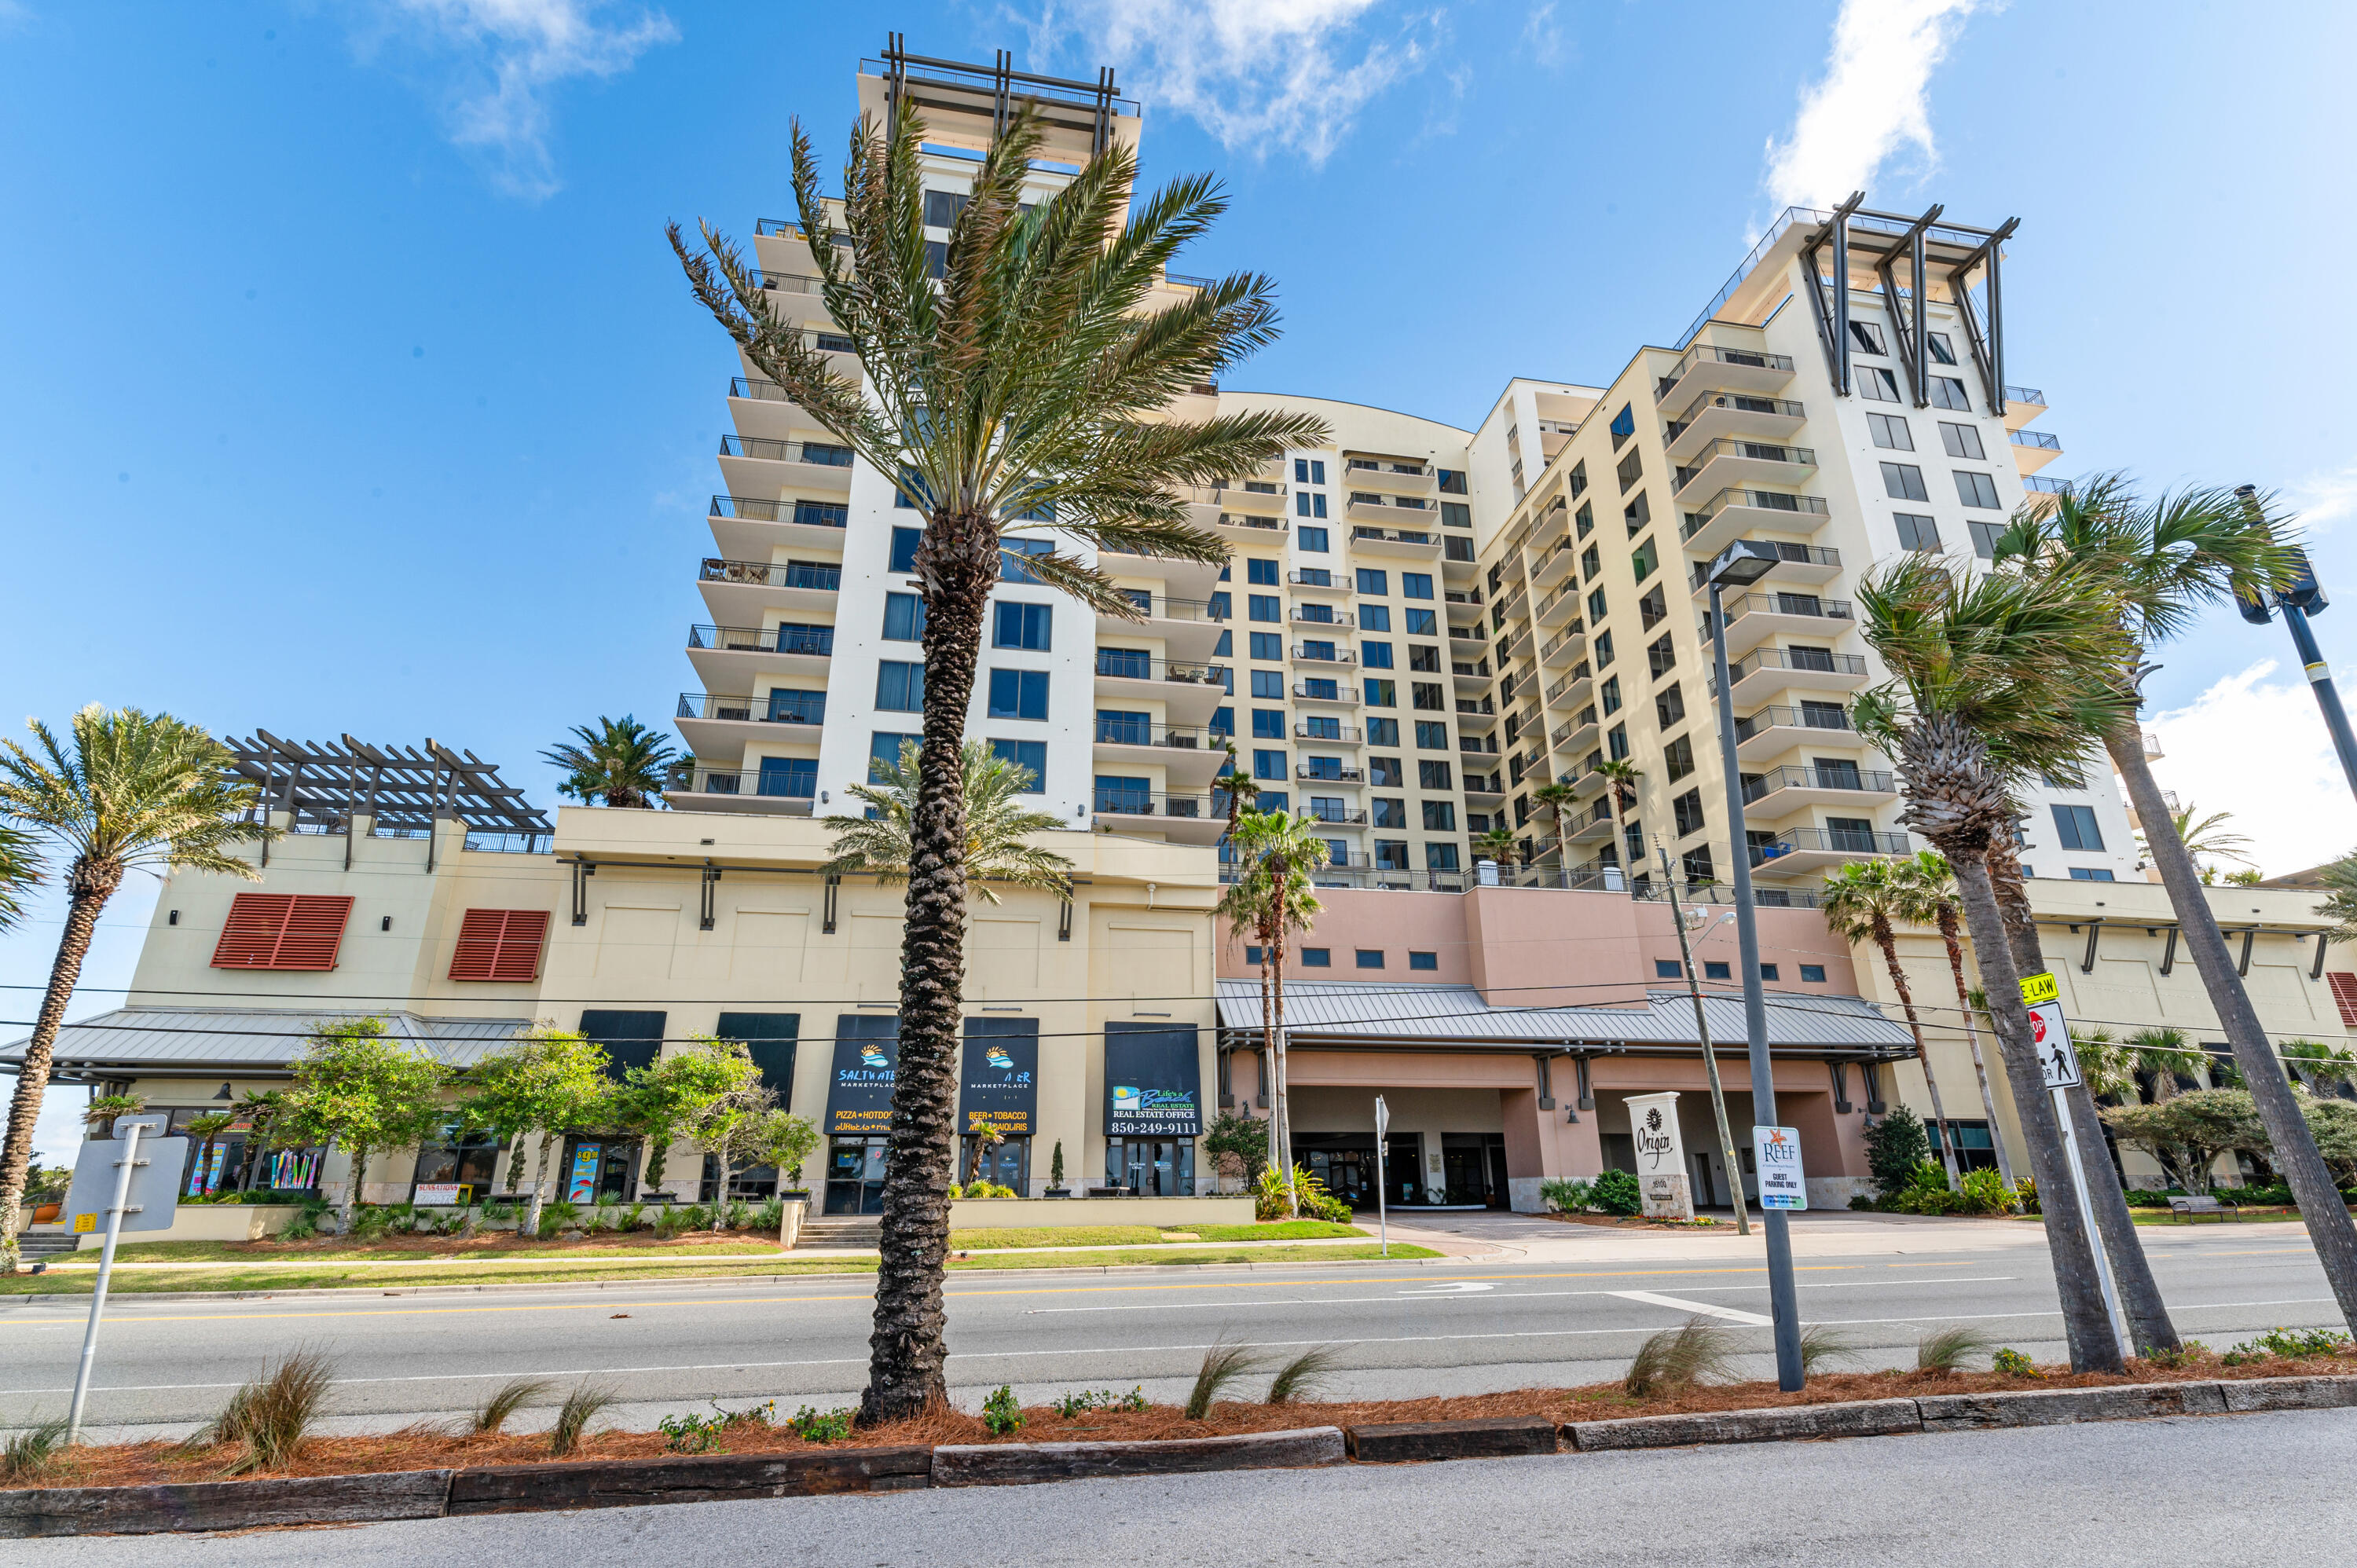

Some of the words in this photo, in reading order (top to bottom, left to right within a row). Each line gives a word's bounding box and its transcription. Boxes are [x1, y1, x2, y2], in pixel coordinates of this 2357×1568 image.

[2031, 978, 2054, 997] LAW
[2032, 1020, 2044, 1033] OP
[838, 1069, 895, 1081] SALTWATE
[2043, 1068, 2054, 1080] OR
[835, 1110, 857, 1119] PIZZA
[863, 1111, 893, 1119] HOTDO
[1135, 1110, 1164, 1119] ESTATE
[1165, 1110, 1195, 1119] OFFICE
[1112, 1122, 1197, 1134] 850-249-9111
[1637, 1127, 1673, 1170] Origin
[1763, 1142, 1795, 1163] REEF
